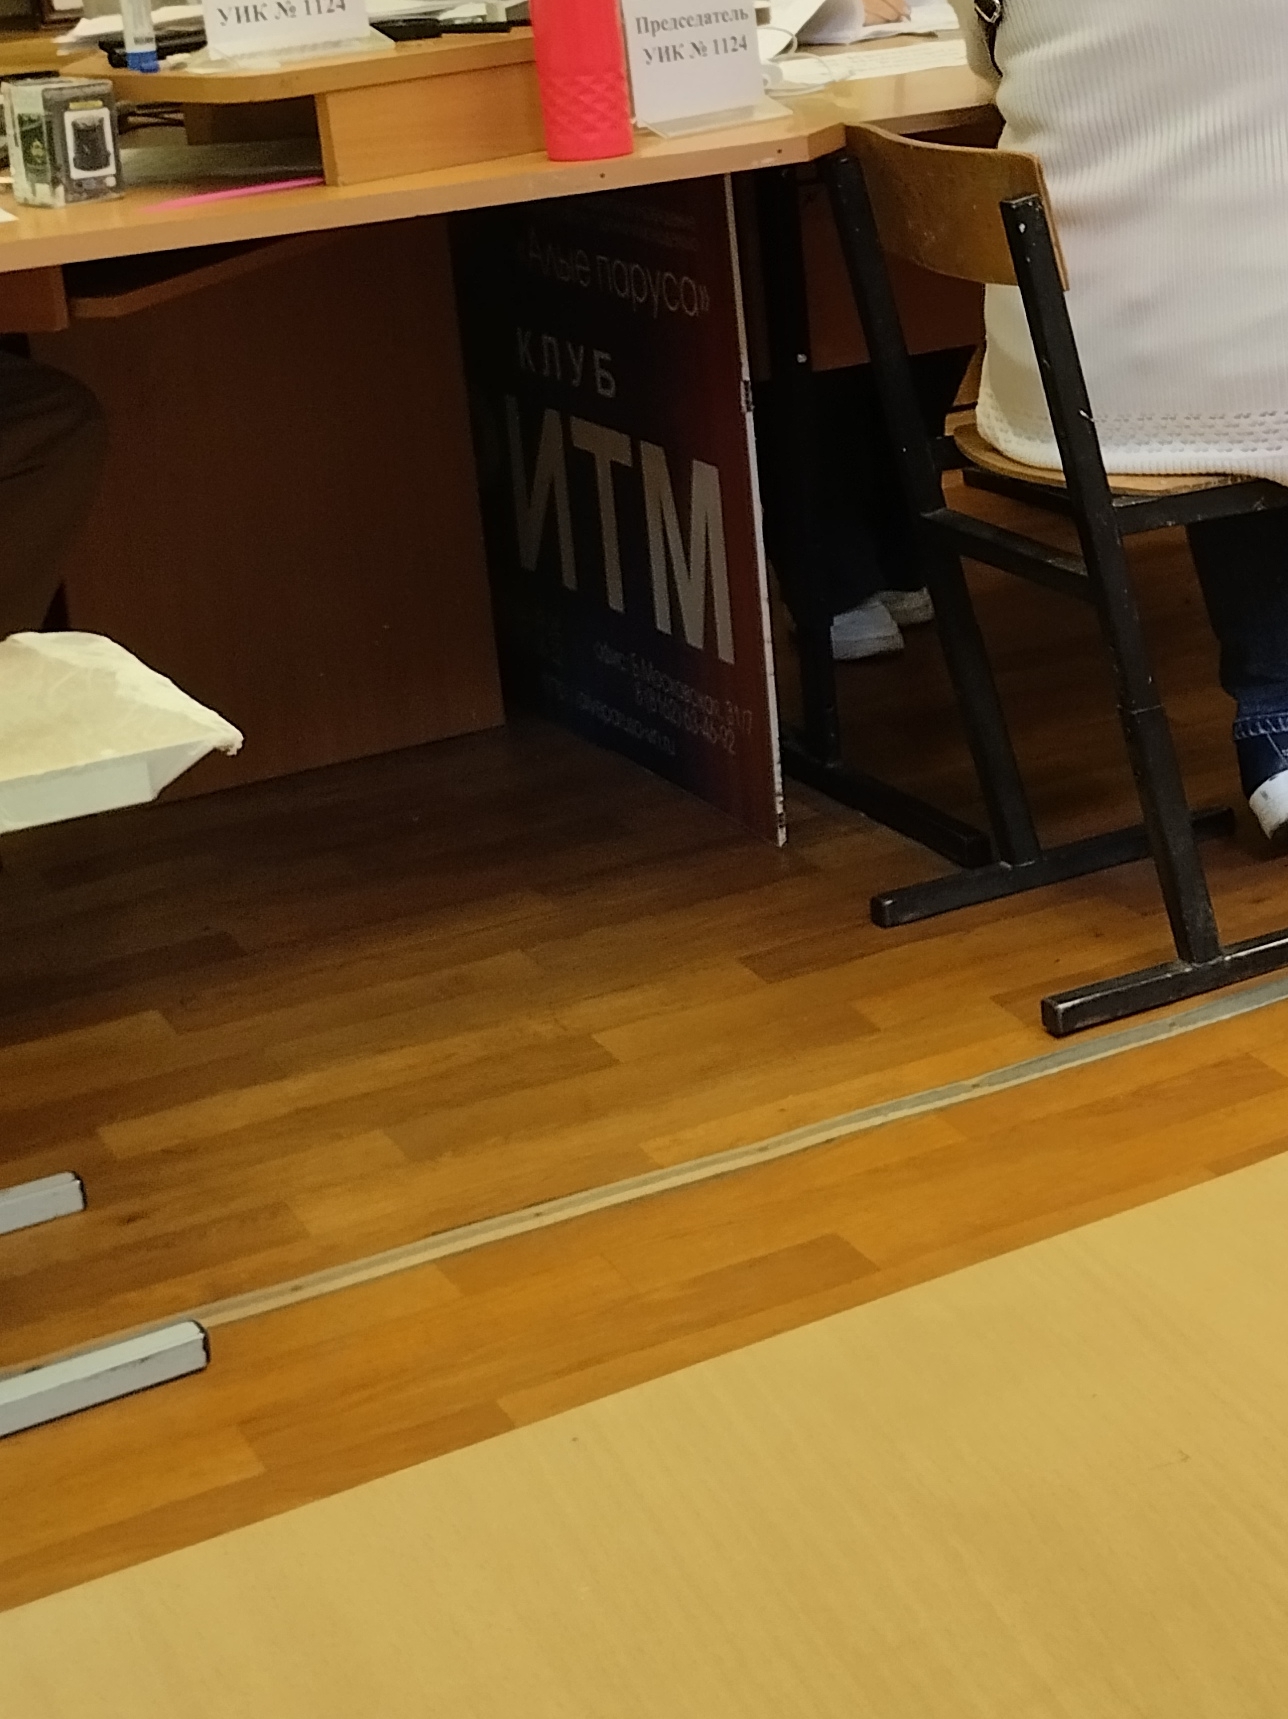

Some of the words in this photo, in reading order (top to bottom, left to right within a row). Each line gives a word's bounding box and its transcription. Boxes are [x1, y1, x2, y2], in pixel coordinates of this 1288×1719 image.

[217, 2, 268, 27] УИК
[274, 0, 297, 20] №
[635, 8, 749, 38] Председатель
[643, 43, 685, 65] УИК
[689, 40, 708, 59] №
[713, 34, 748, 55] 1124
[595, 255, 711, 319] паруса»
[515, 327, 617, 399] КЛУБ
[506, 393, 736, 664] ИТМ
